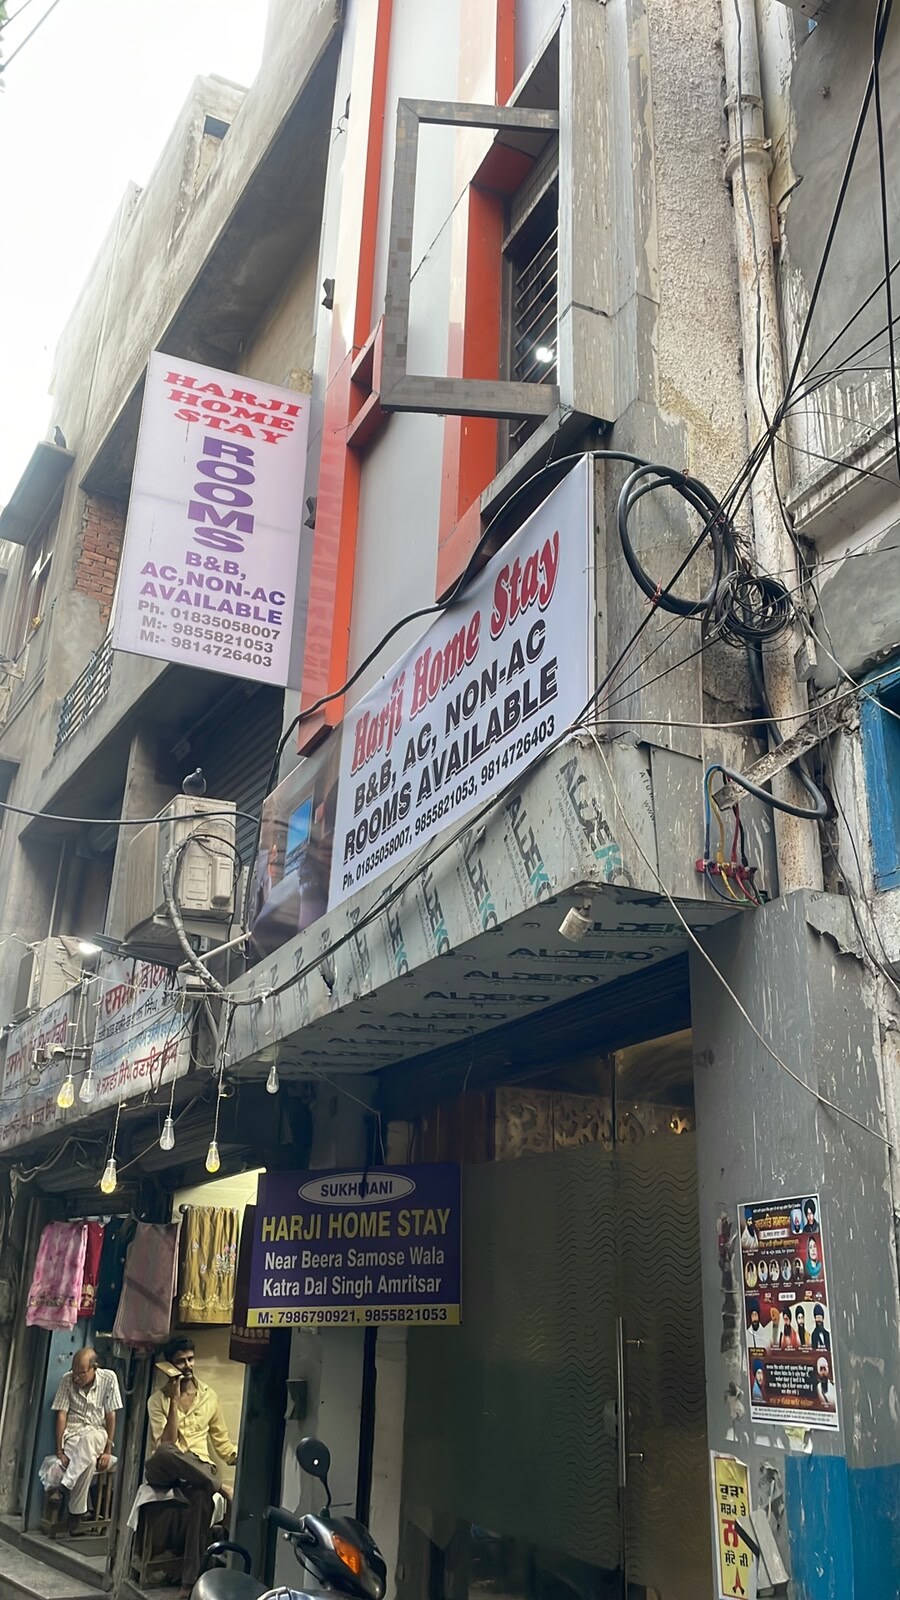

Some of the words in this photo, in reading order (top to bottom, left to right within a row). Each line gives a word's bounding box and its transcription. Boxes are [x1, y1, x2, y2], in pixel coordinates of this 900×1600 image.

[163, 371, 302, 417] HARJI
[167, 389, 294, 432] HOME
[174, 408, 288, 445] STAY
[187, 436, 256, 553] ROOMS
[185, 551, 247, 580] B&B,
[137, 600, 165, 616] Ph.
[170, 607, 281, 640] 01835058007
[140, 581, 283, 626] AVAILABLE
[170, 636, 273, 667] 9814726403
[172, 622, 274, 653] 9855821053
[350, 670, 405, 776] Harji
[409, 610, 481, 720] Home
[489, 530, 559, 641] Stay
[353, 759, 397, 818] B&B,
[402, 722, 438, 776] AC,
[444, 619, 547, 739] NON-AC
[343, 782, 412, 865] ROOMS
[416, 656, 559, 808] AVAILABLE
[342, 871, 355, 891] Ph.
[356, 827, 413, 880] 01835058007,
[415, 775, 478, 835] 9855821053,
[481, 714, 555, 785] 9814726403
[507, 947, 654, 961] ALDEKO
[261, 1214, 322, 1242] HARJI
[328, 1211, 391, 1240] HOME
[397, 1208, 451, 1238] STAY
[264, 1251, 298, 1270] Near
[301, 1250, 343, 1269] Beera
[347, 1248, 405, 1267] Samose
[409, 1246, 445, 1265] Wala
[263, 1278, 300, 1297] Katra
[304, 1276, 327, 1295] Dal
[331, 1276, 373, 1299] Singh
[377, 1274, 442, 1294] Amritsar
[257, 1311, 274, 1324] M:
[278, 1311, 360, 1325] 7986790921,
[365, 1308, 447, 1321] 9855821053
